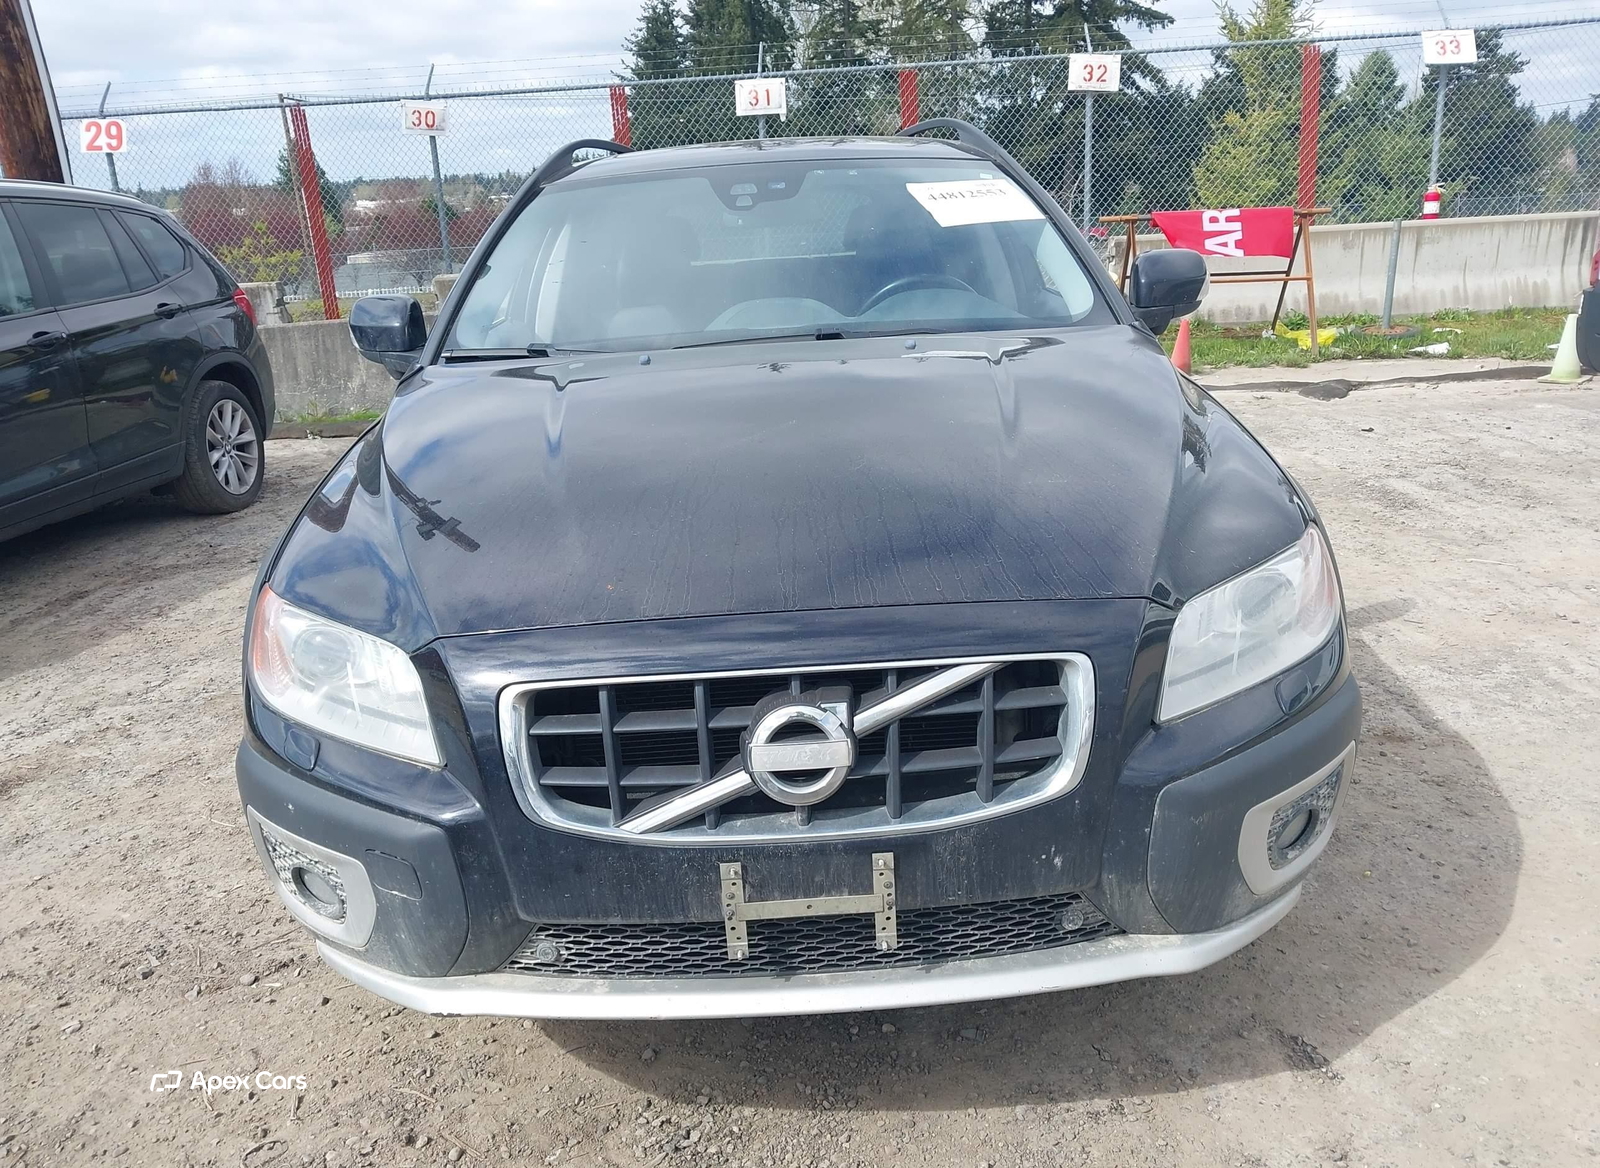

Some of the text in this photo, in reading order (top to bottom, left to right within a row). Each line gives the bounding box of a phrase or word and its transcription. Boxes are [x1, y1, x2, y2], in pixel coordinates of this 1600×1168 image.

[1435, 39, 1461, 56] 33
[1083, 64, 1107, 83] 32
[748, 88, 771, 107] 31
[411, 109, 436, 129] 30
[85, 120, 123, 152] 29
[1201, 208, 1245, 258] AR
